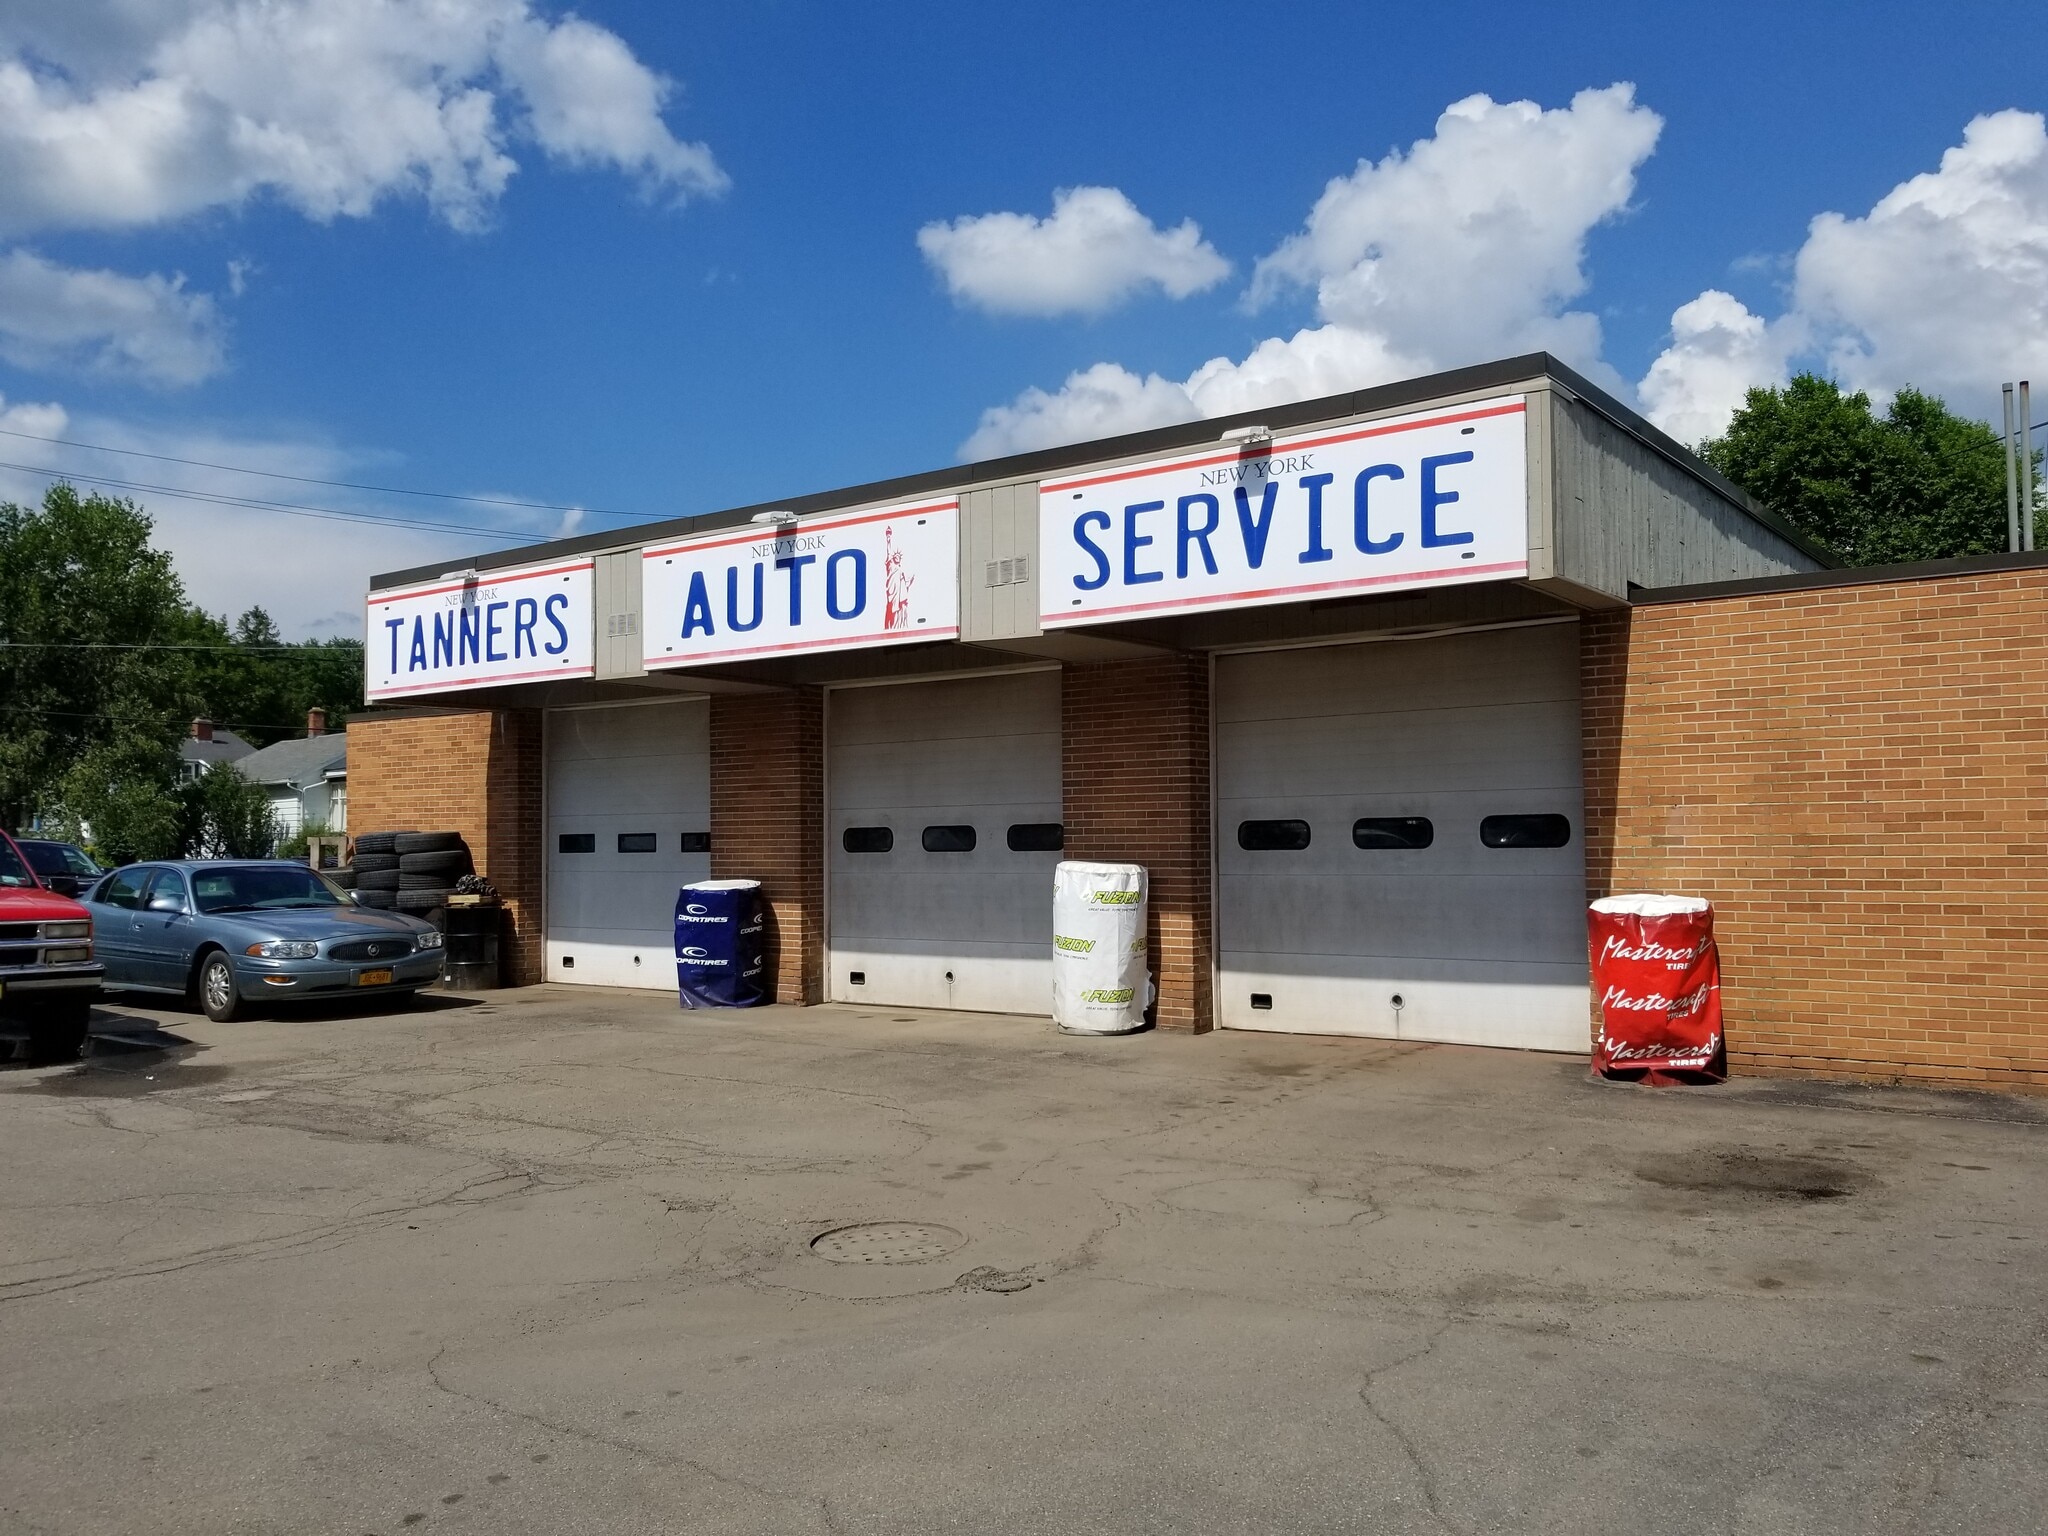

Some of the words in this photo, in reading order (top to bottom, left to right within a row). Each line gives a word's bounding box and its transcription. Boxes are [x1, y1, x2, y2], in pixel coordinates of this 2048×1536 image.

[1199, 463, 1252, 487] NEW
[1253, 453, 1315, 479] YORK
[1072, 450, 1475, 591] SERVICE
[751, 541, 783, 559] NEW
[783, 534, 826, 553] YORK
[445, 592, 467, 607] NEW
[468, 587, 499, 602] YORK
[681, 548, 867, 639] AUTO
[385, 593, 569, 675] TANNERS
[1091, 890, 1141, 904] FUZION
[1088, 987, 1135, 1003] FUZION
[1601, 982, 1719, 1015] Mastercraft
[1668, 1059, 1707, 1067] TIRES
